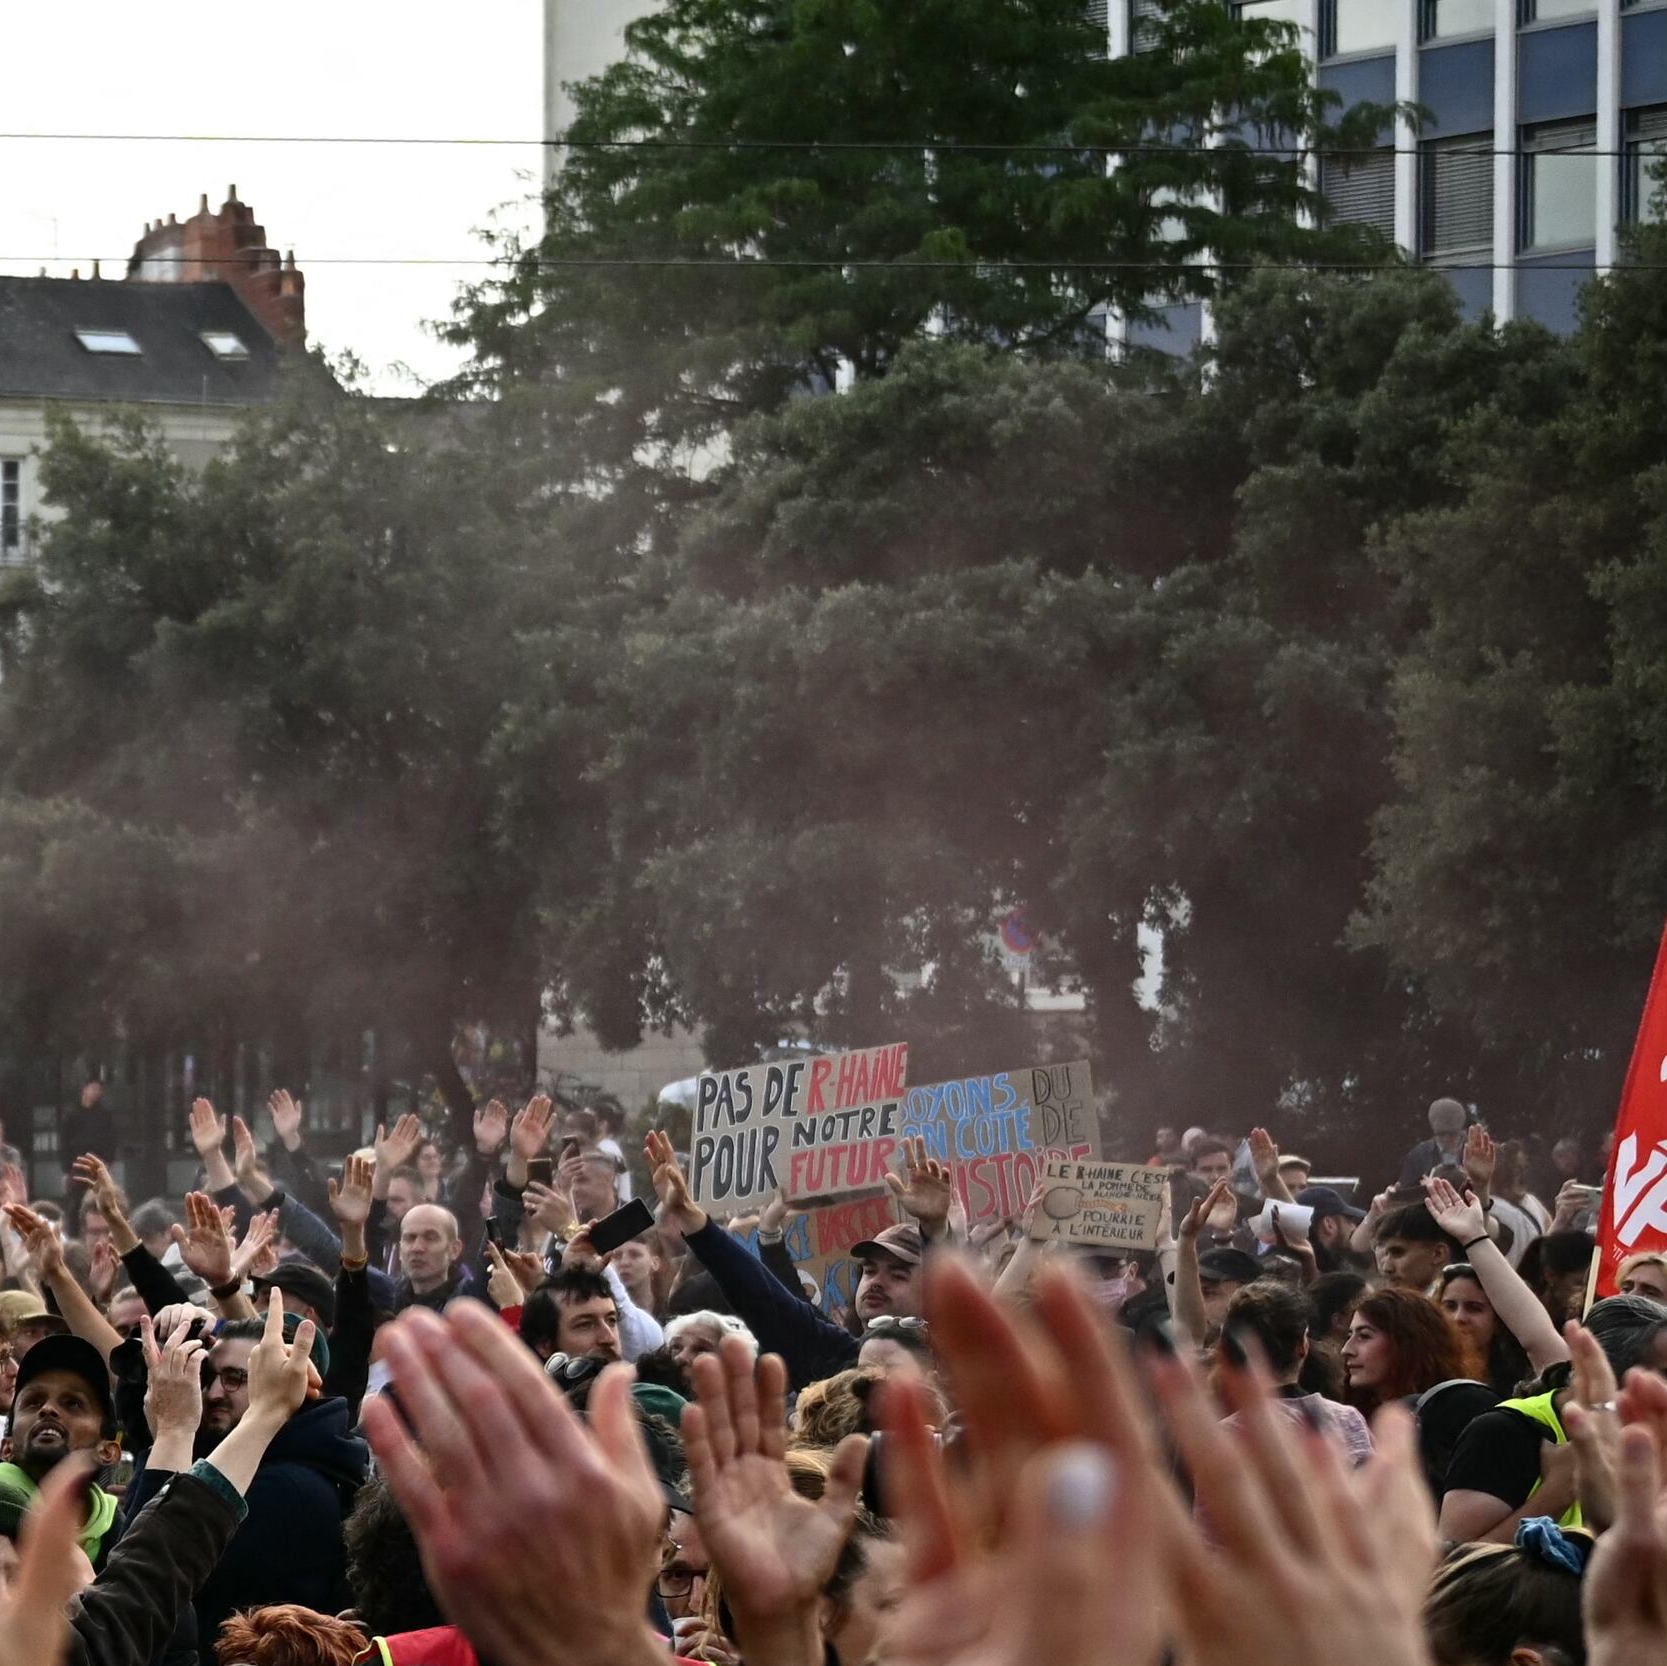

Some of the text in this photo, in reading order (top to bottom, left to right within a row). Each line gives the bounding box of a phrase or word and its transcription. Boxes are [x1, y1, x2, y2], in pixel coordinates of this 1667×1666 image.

[696, 1072, 753, 1133] PAS
[762, 1062, 805, 1118] DE
[901, 1067, 1072, 1122] OYONS DU
[693, 1103, 899, 1202] POUR NOTRE
[898, 1120, 949, 1161] ON
[1041, 1101, 1086, 1146] DE
[790, 1137, 896, 1196] FUTUR
[1047, 1164, 1071, 1179] LE
[1131, 1170, 1168, 1184] C'EST
[1082, 1181, 1150, 1193] LA POMME DE
[1083, 1210, 1145, 1226] POURRIE
